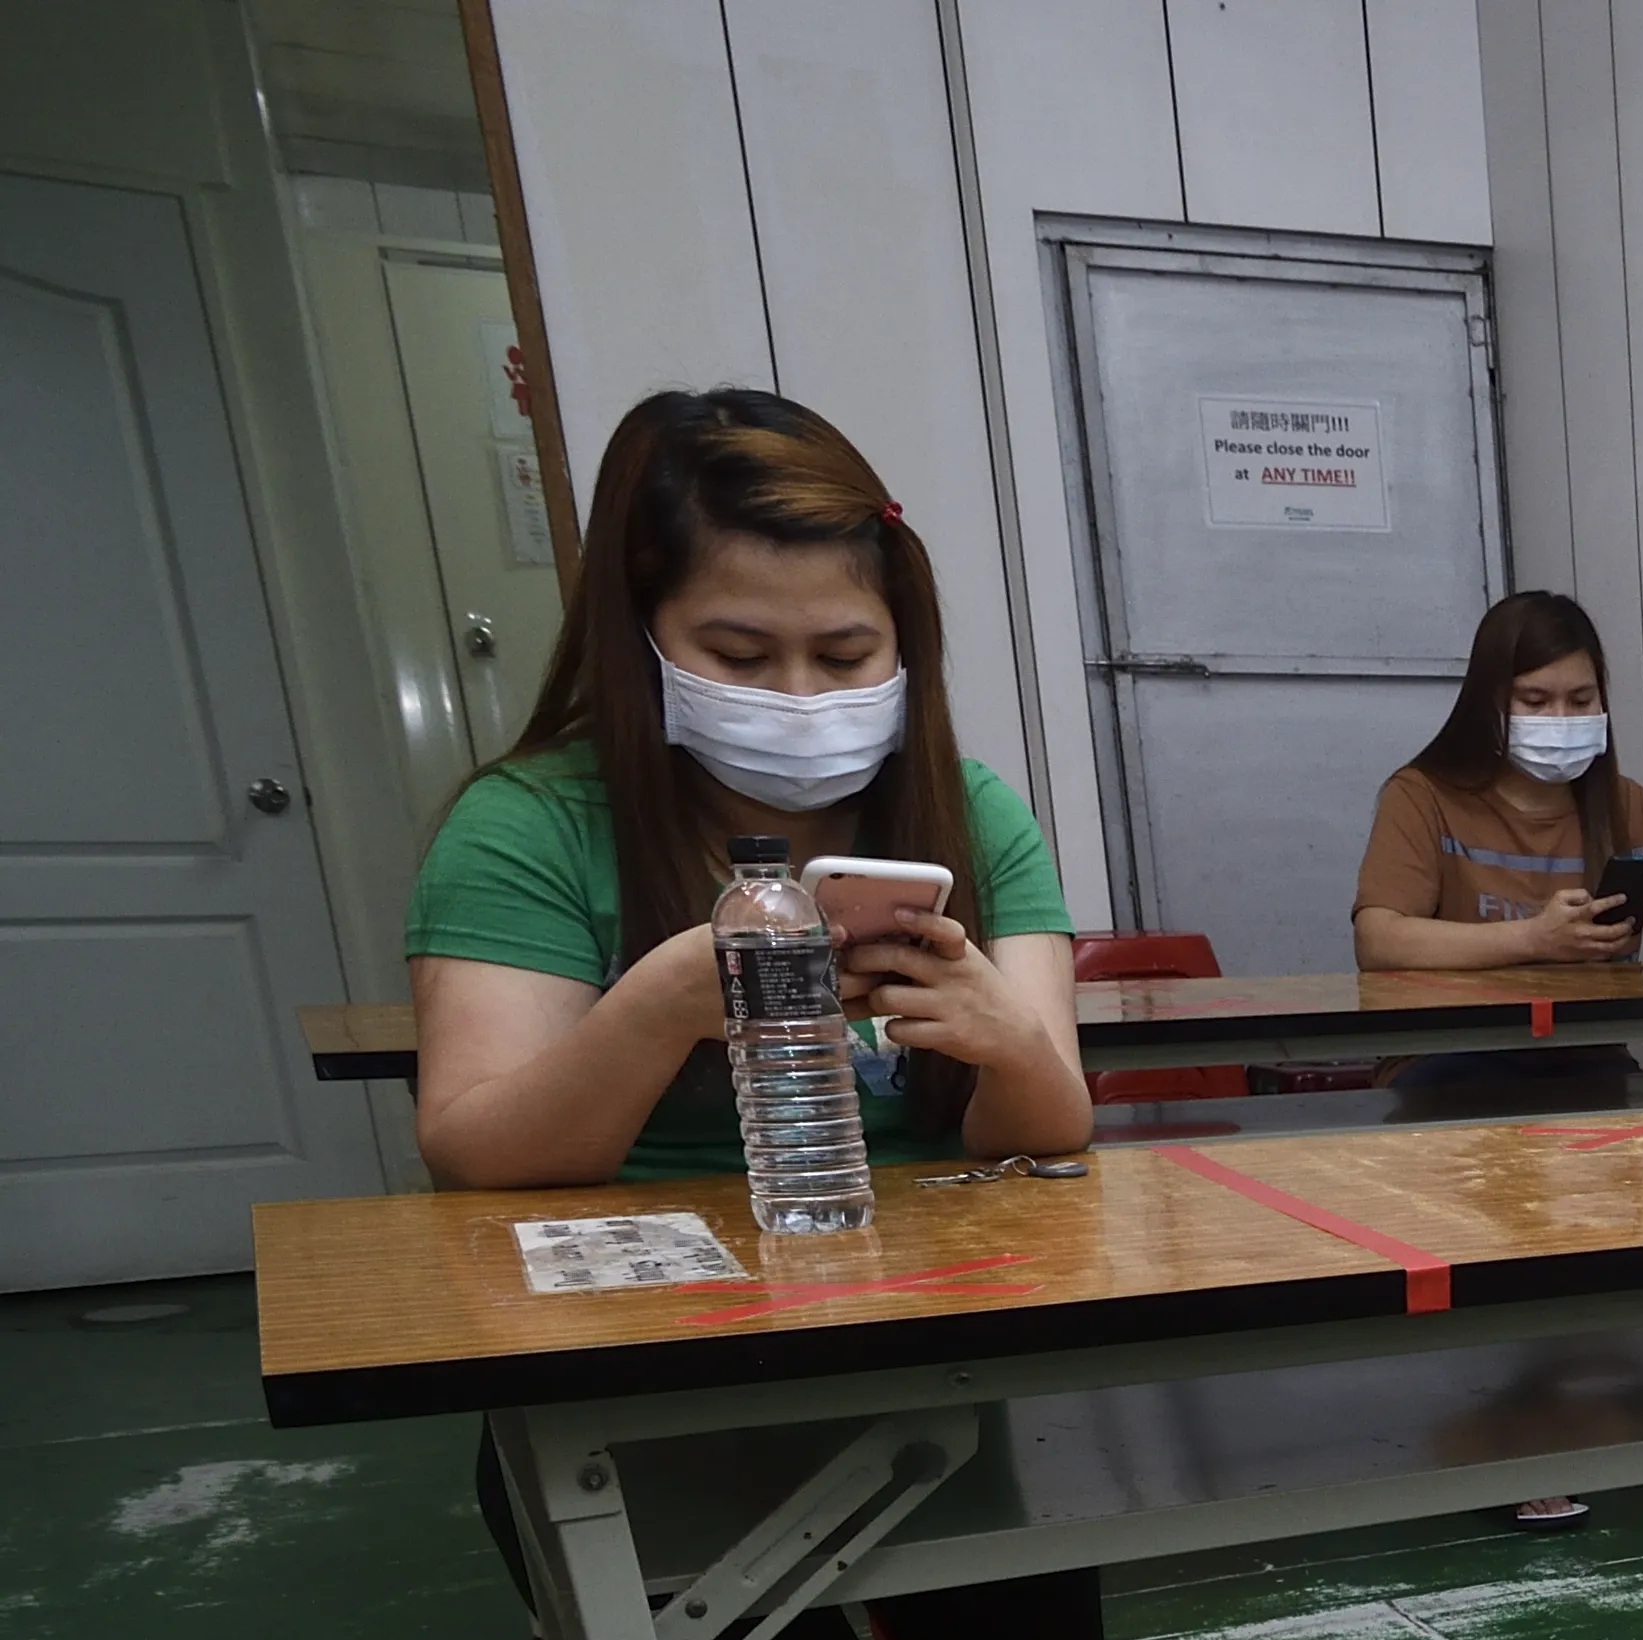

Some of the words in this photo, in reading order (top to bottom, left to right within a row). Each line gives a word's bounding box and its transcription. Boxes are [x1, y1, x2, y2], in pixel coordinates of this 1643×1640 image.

[1214, 439, 1262, 454] Please
[1266, 442, 1304, 456] close
[1308, 443, 1332, 457] the
[1336, 444, 1370, 458] door
[1234, 469, 1249, 480] at
[1262, 467, 1296, 482] ANY
[1301, 468, 1356, 485] TIME!!
